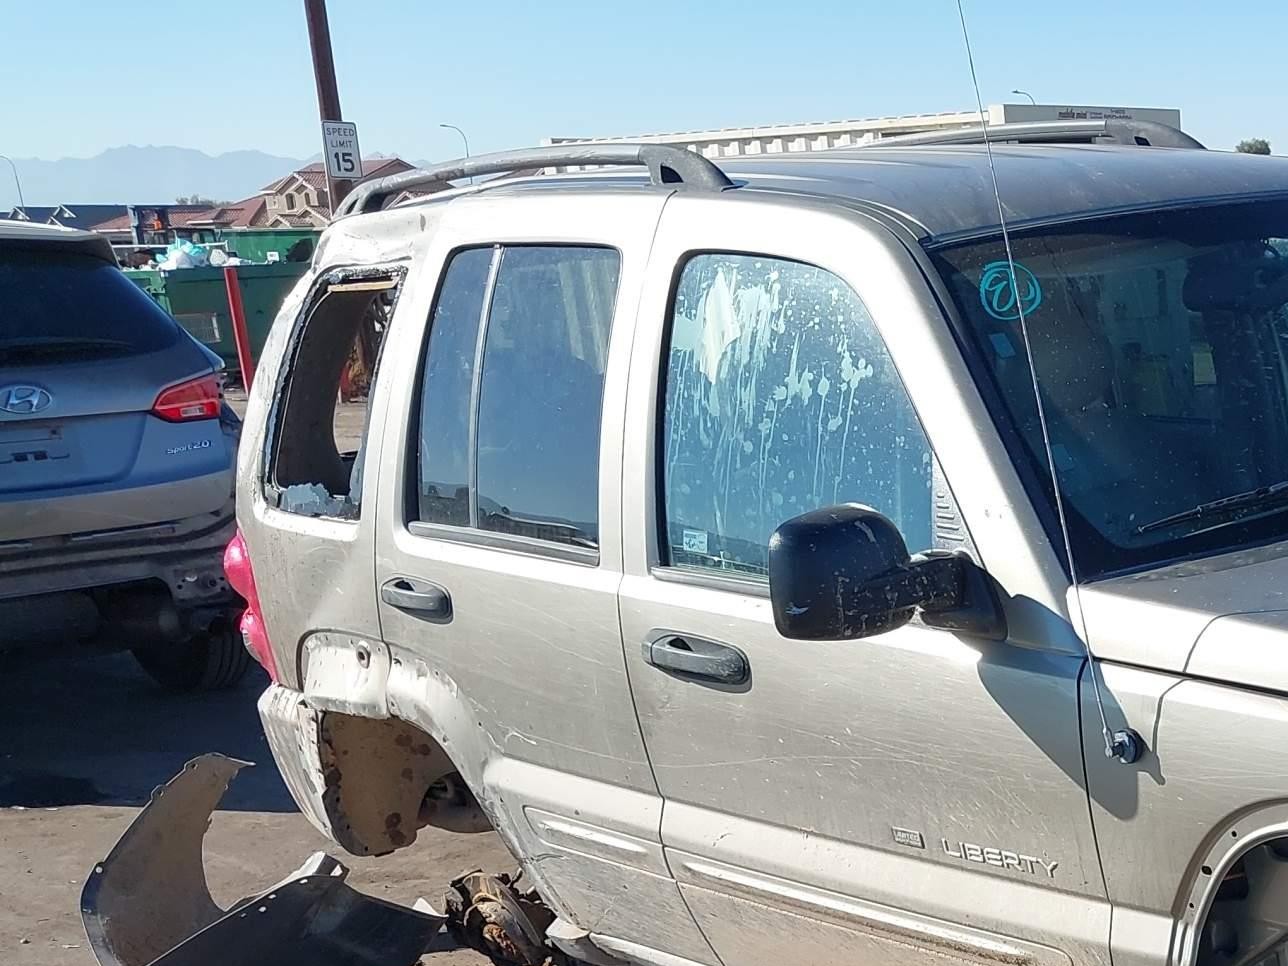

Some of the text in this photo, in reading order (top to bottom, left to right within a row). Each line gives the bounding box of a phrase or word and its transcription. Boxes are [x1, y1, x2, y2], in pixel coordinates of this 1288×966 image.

[326, 127, 355, 136] SPEED
[331, 140, 353, 149] LIMIT
[334, 151, 355, 173] 15
[941, 837, 1059, 878] LIBERTY
